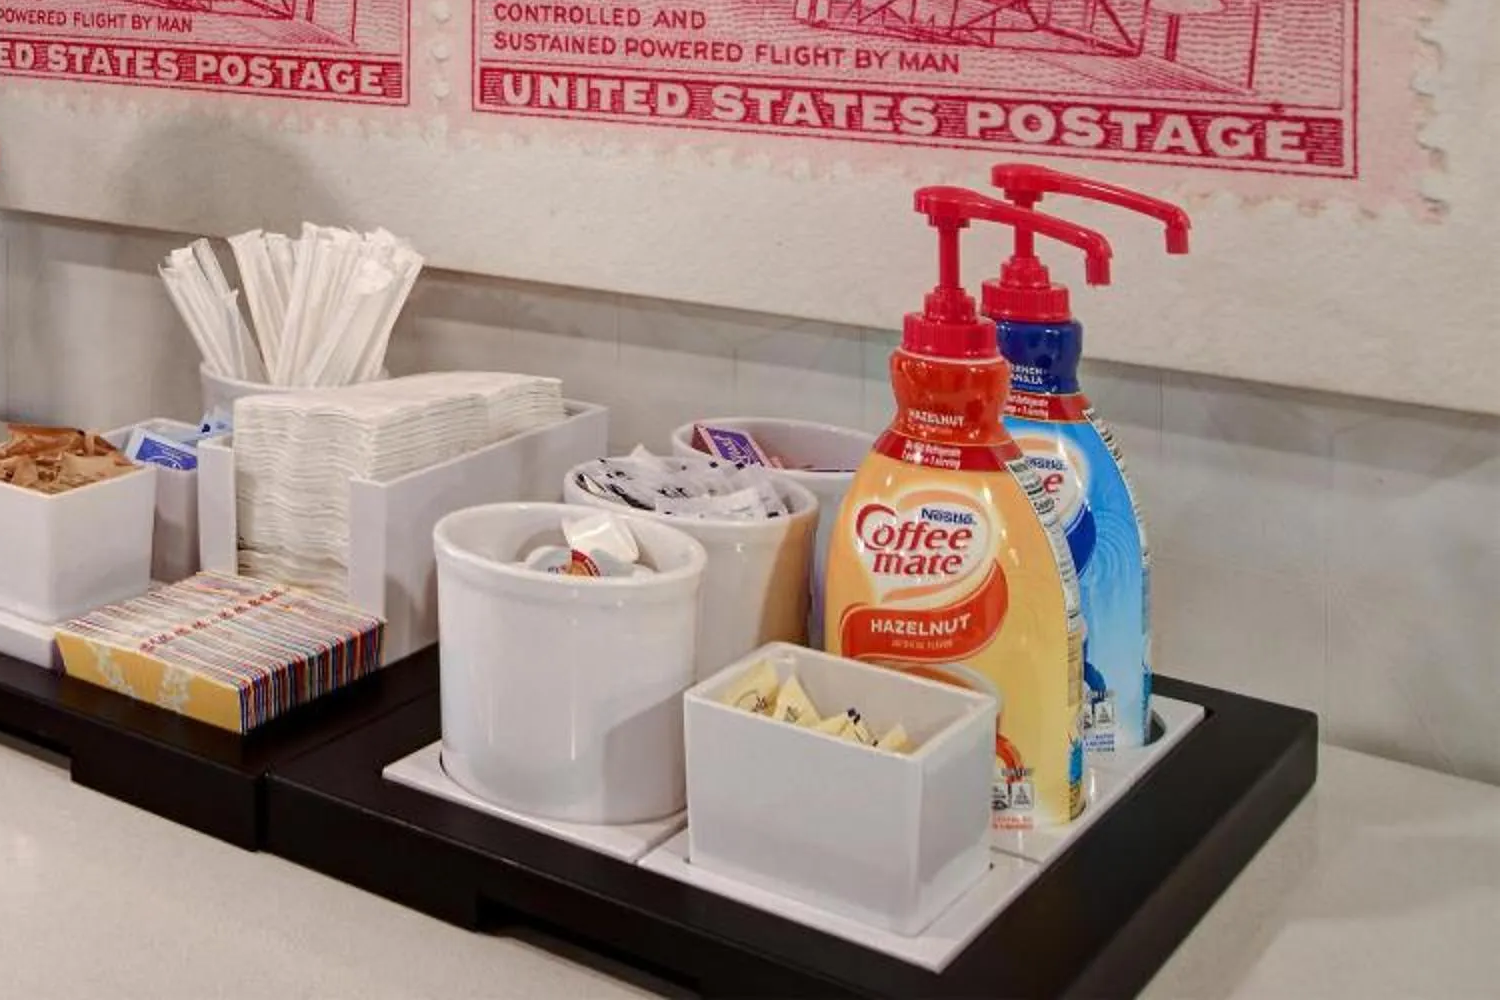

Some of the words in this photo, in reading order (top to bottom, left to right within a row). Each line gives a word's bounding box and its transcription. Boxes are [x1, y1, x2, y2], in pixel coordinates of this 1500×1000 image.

[73, 12, 127, 31] FLIGHT
[131, 16, 153, 32] BY
[157, 15, 193, 33] MAN
[494, 3, 641, 27] CONTROLLED
[653, 8, 707, 30] AND
[47, 43, 180, 81] STATES
[196, 53, 384, 96] POSTAGE
[494, 33, 617, 56] SUSTAINED
[625, 38, 743, 63] POWERED
[755, 44, 846, 69] FLIGHT
[855, 50, 889, 70] BY
[899, 50, 960, 75] MAN
[502, 73, 691, 118] UNITED
[711, 85, 940, 137] STATES
[966, 101, 1310, 161] POSTAGE
[855, 503, 973, 551] Coffee
[872, 553, 963, 576] mate
[870, 612, 971, 637] HAZELNUT
